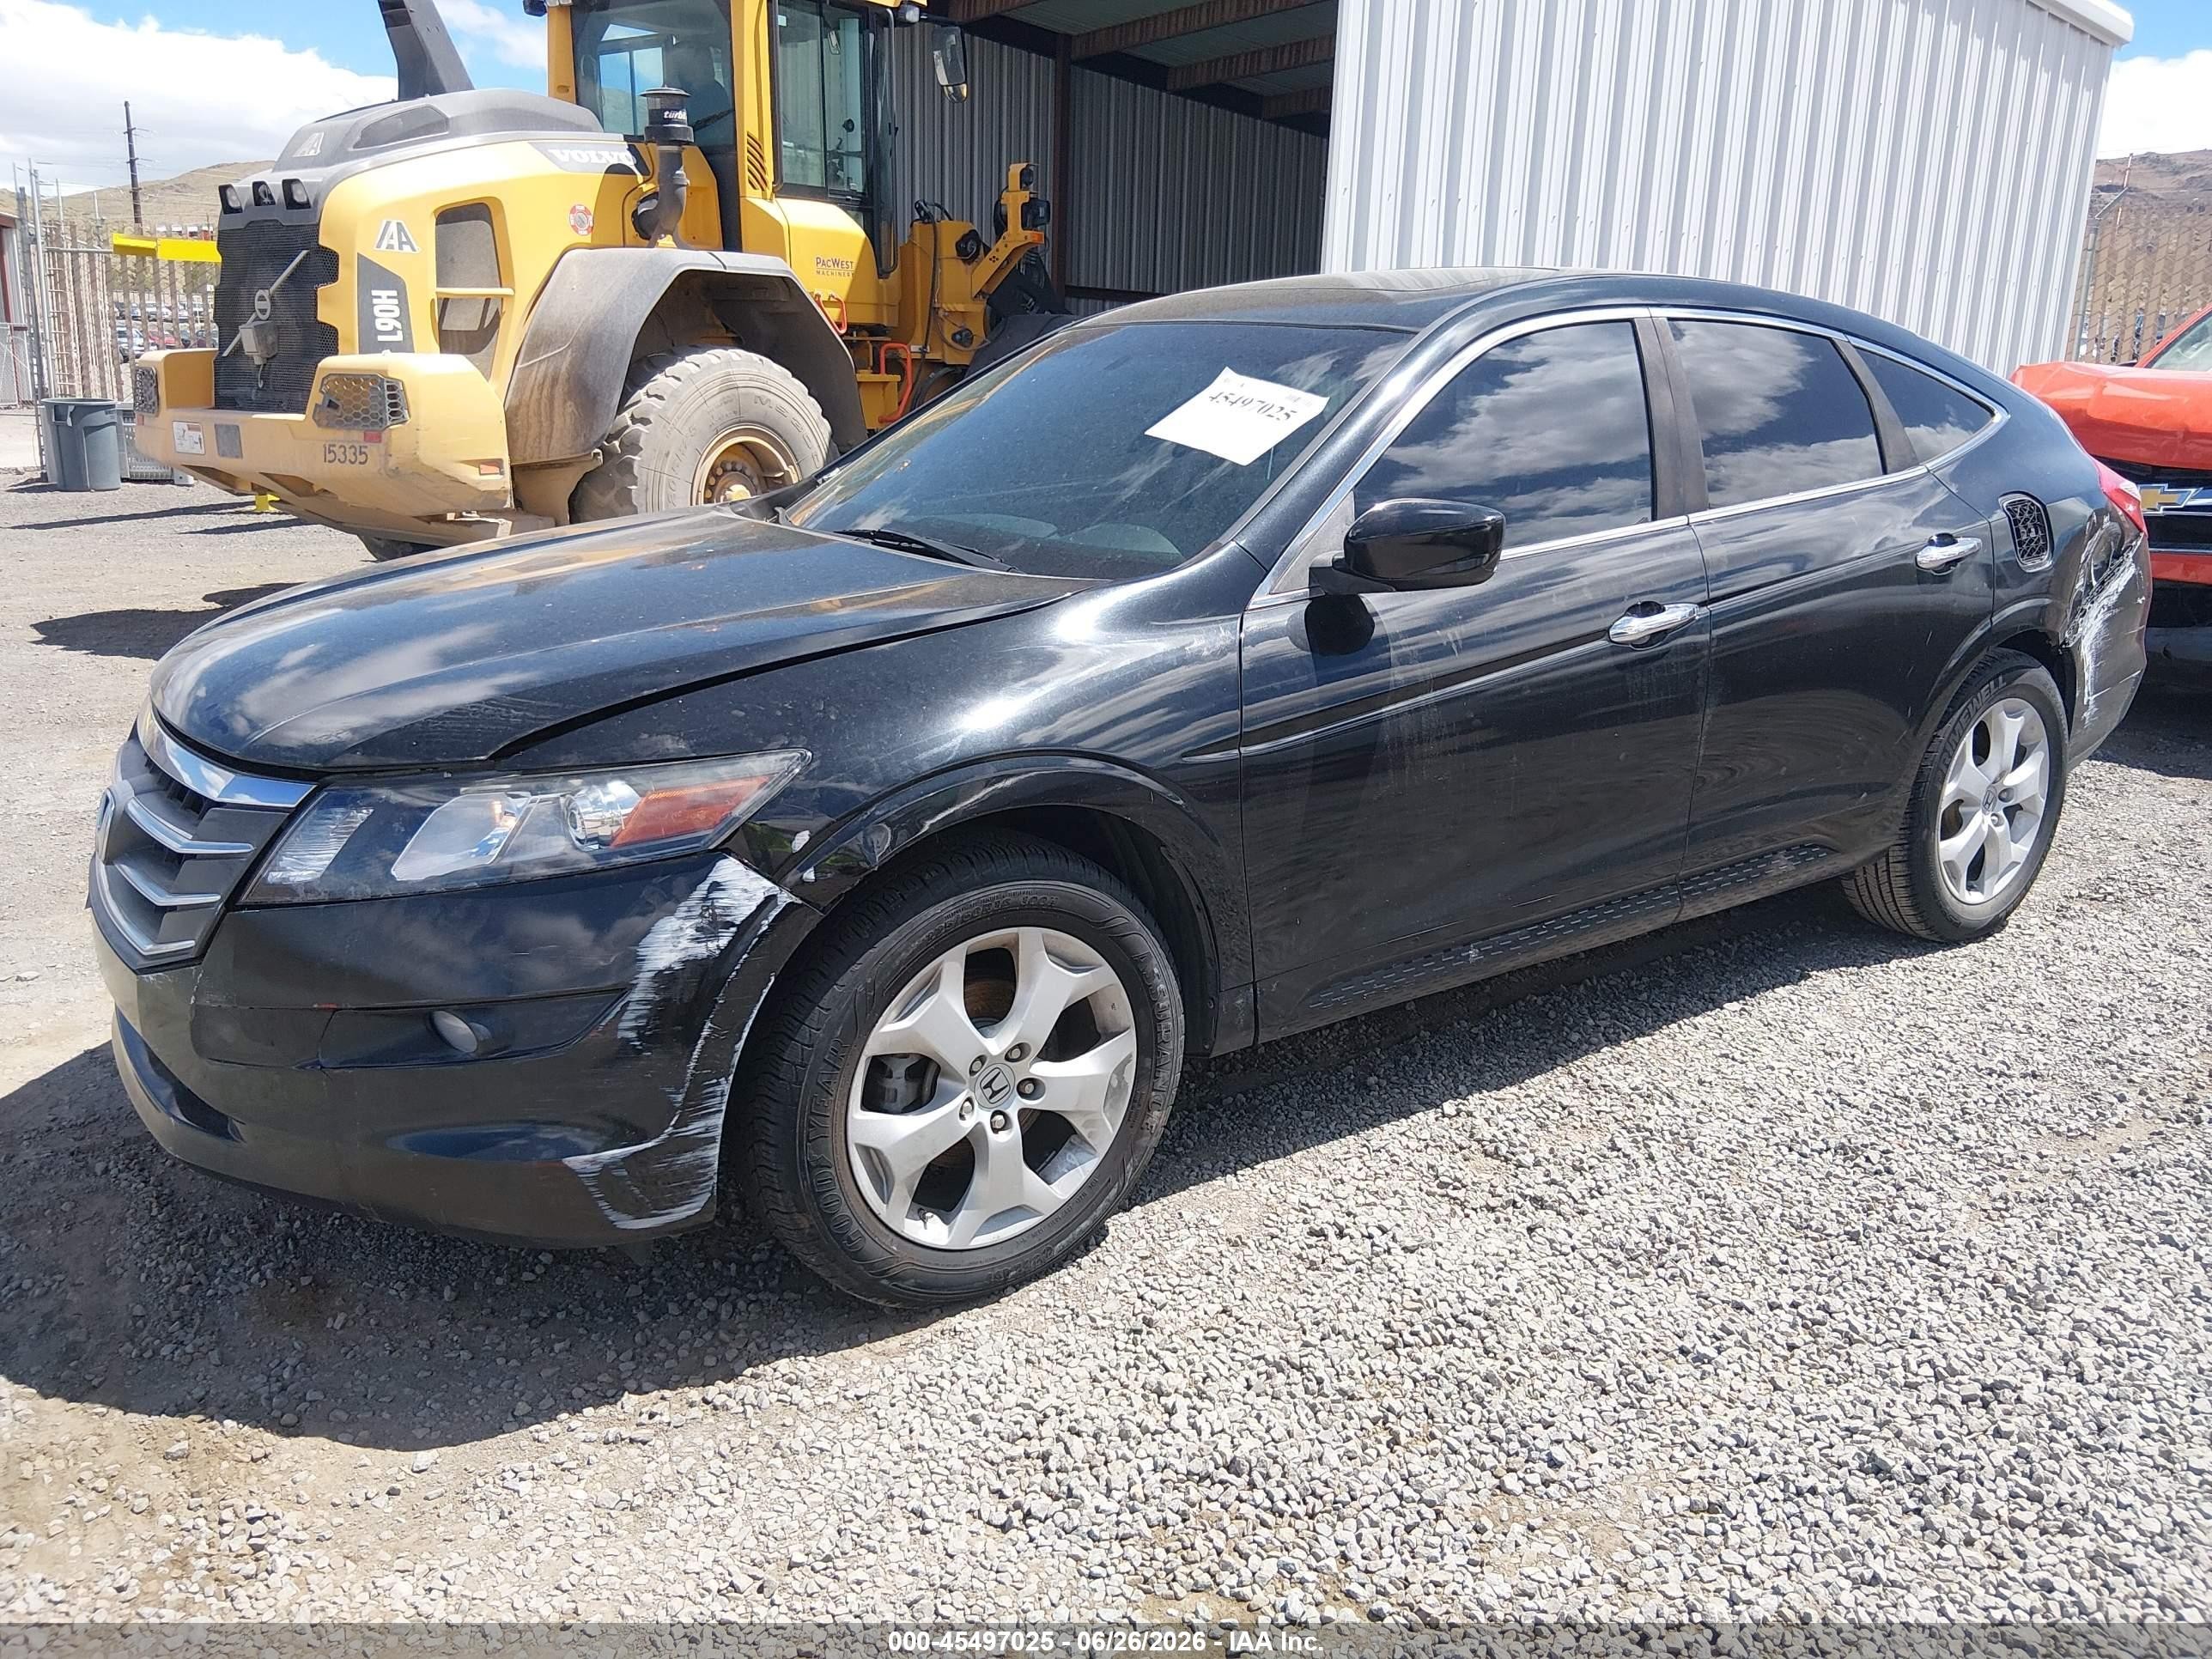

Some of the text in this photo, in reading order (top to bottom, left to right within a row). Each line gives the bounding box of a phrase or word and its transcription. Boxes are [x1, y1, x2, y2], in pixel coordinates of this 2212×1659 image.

[548, 149, 637, 166] VOLVO
[371, 290, 404, 342] L90H
[1209, 392, 1297, 420] 45497025
[323, 443, 368, 465] 15335
